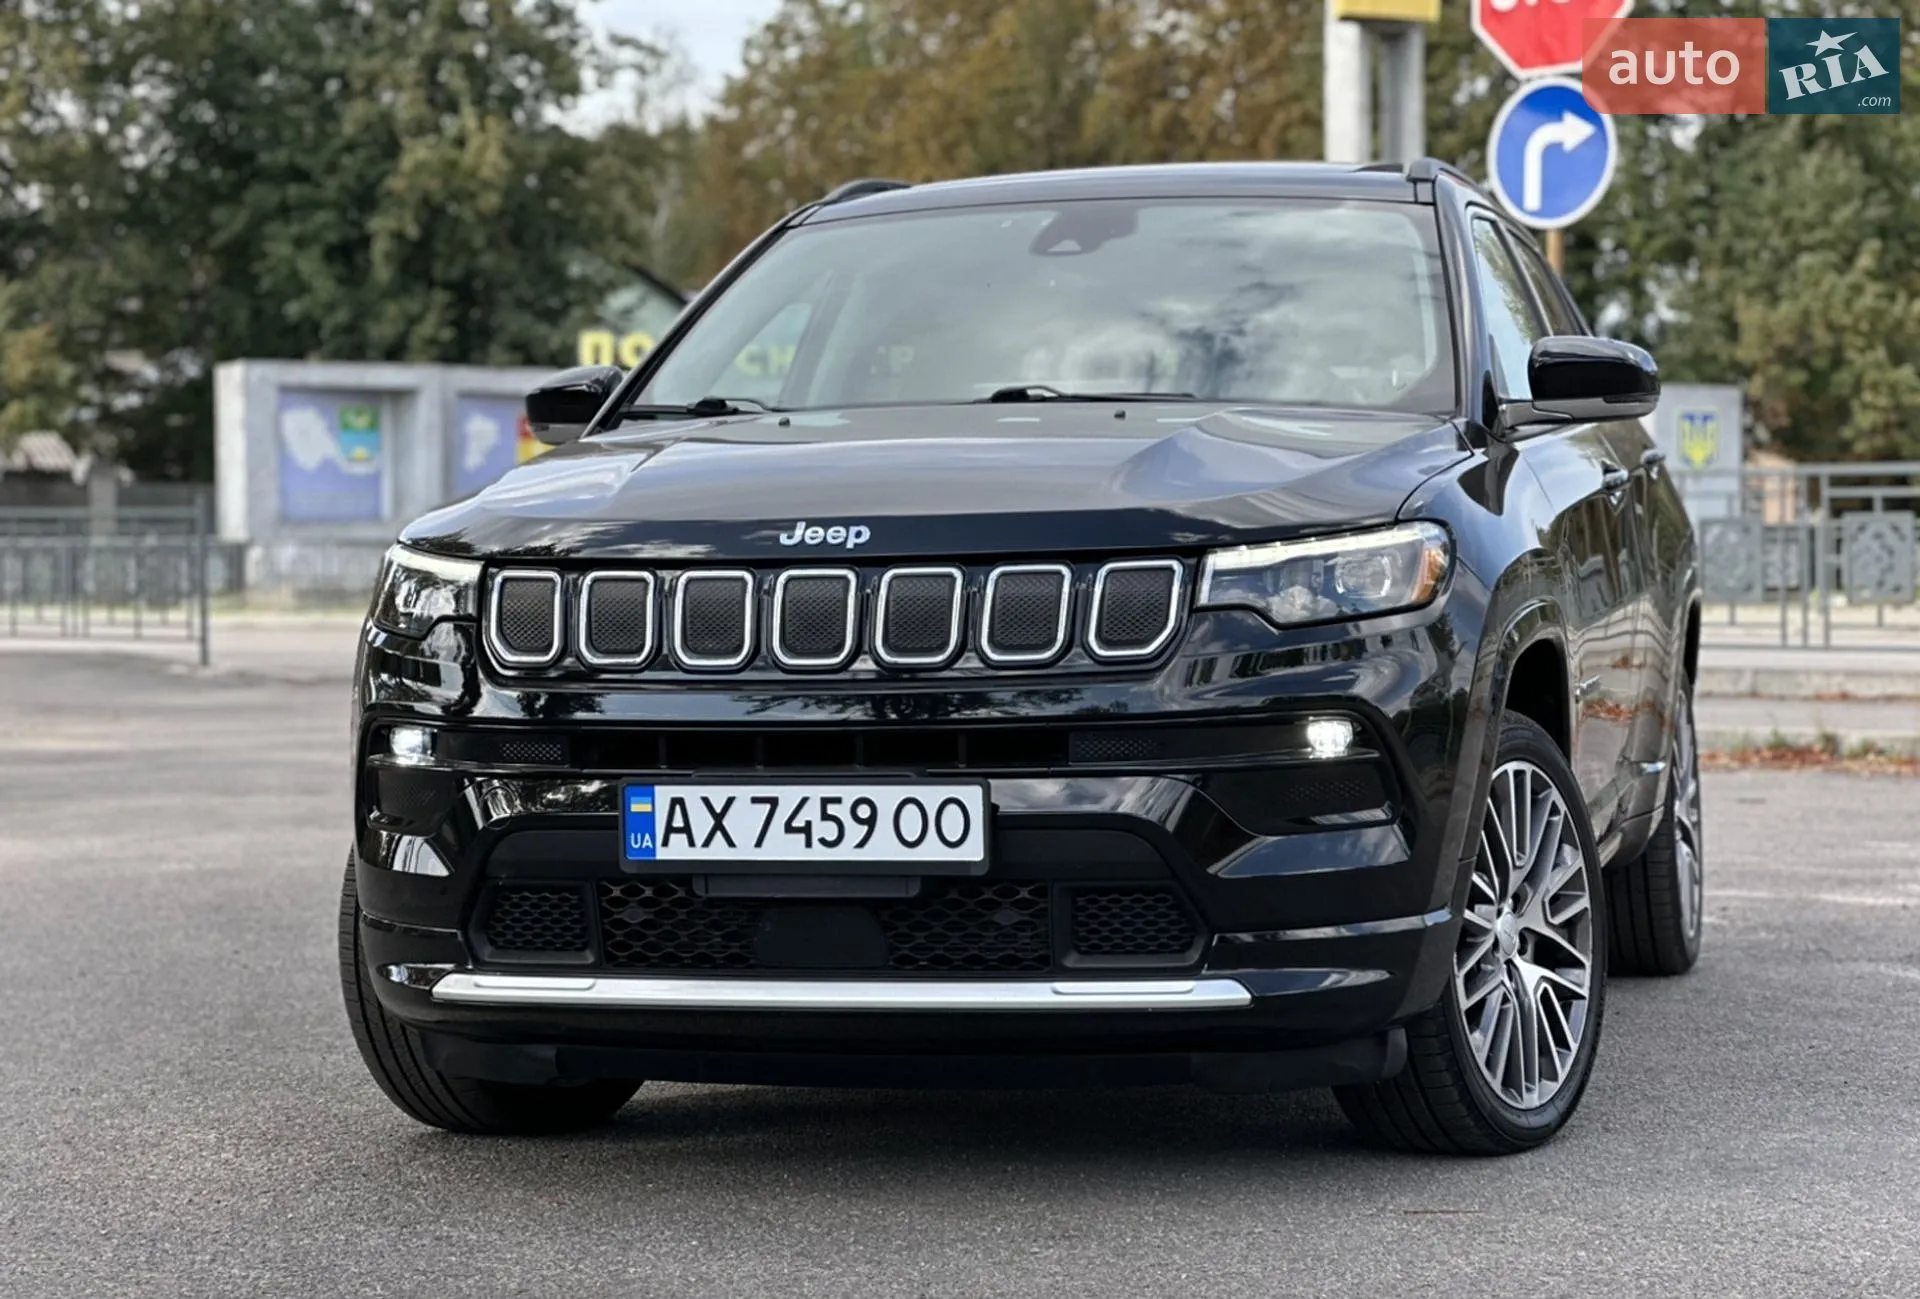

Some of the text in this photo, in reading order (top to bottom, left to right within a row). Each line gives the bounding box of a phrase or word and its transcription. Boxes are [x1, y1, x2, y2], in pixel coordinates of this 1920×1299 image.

[779, 521, 871, 549] Jeep
[661, 796, 737, 849] AX
[750, 796, 878, 849] 7459
[631, 833, 653, 849] UA
